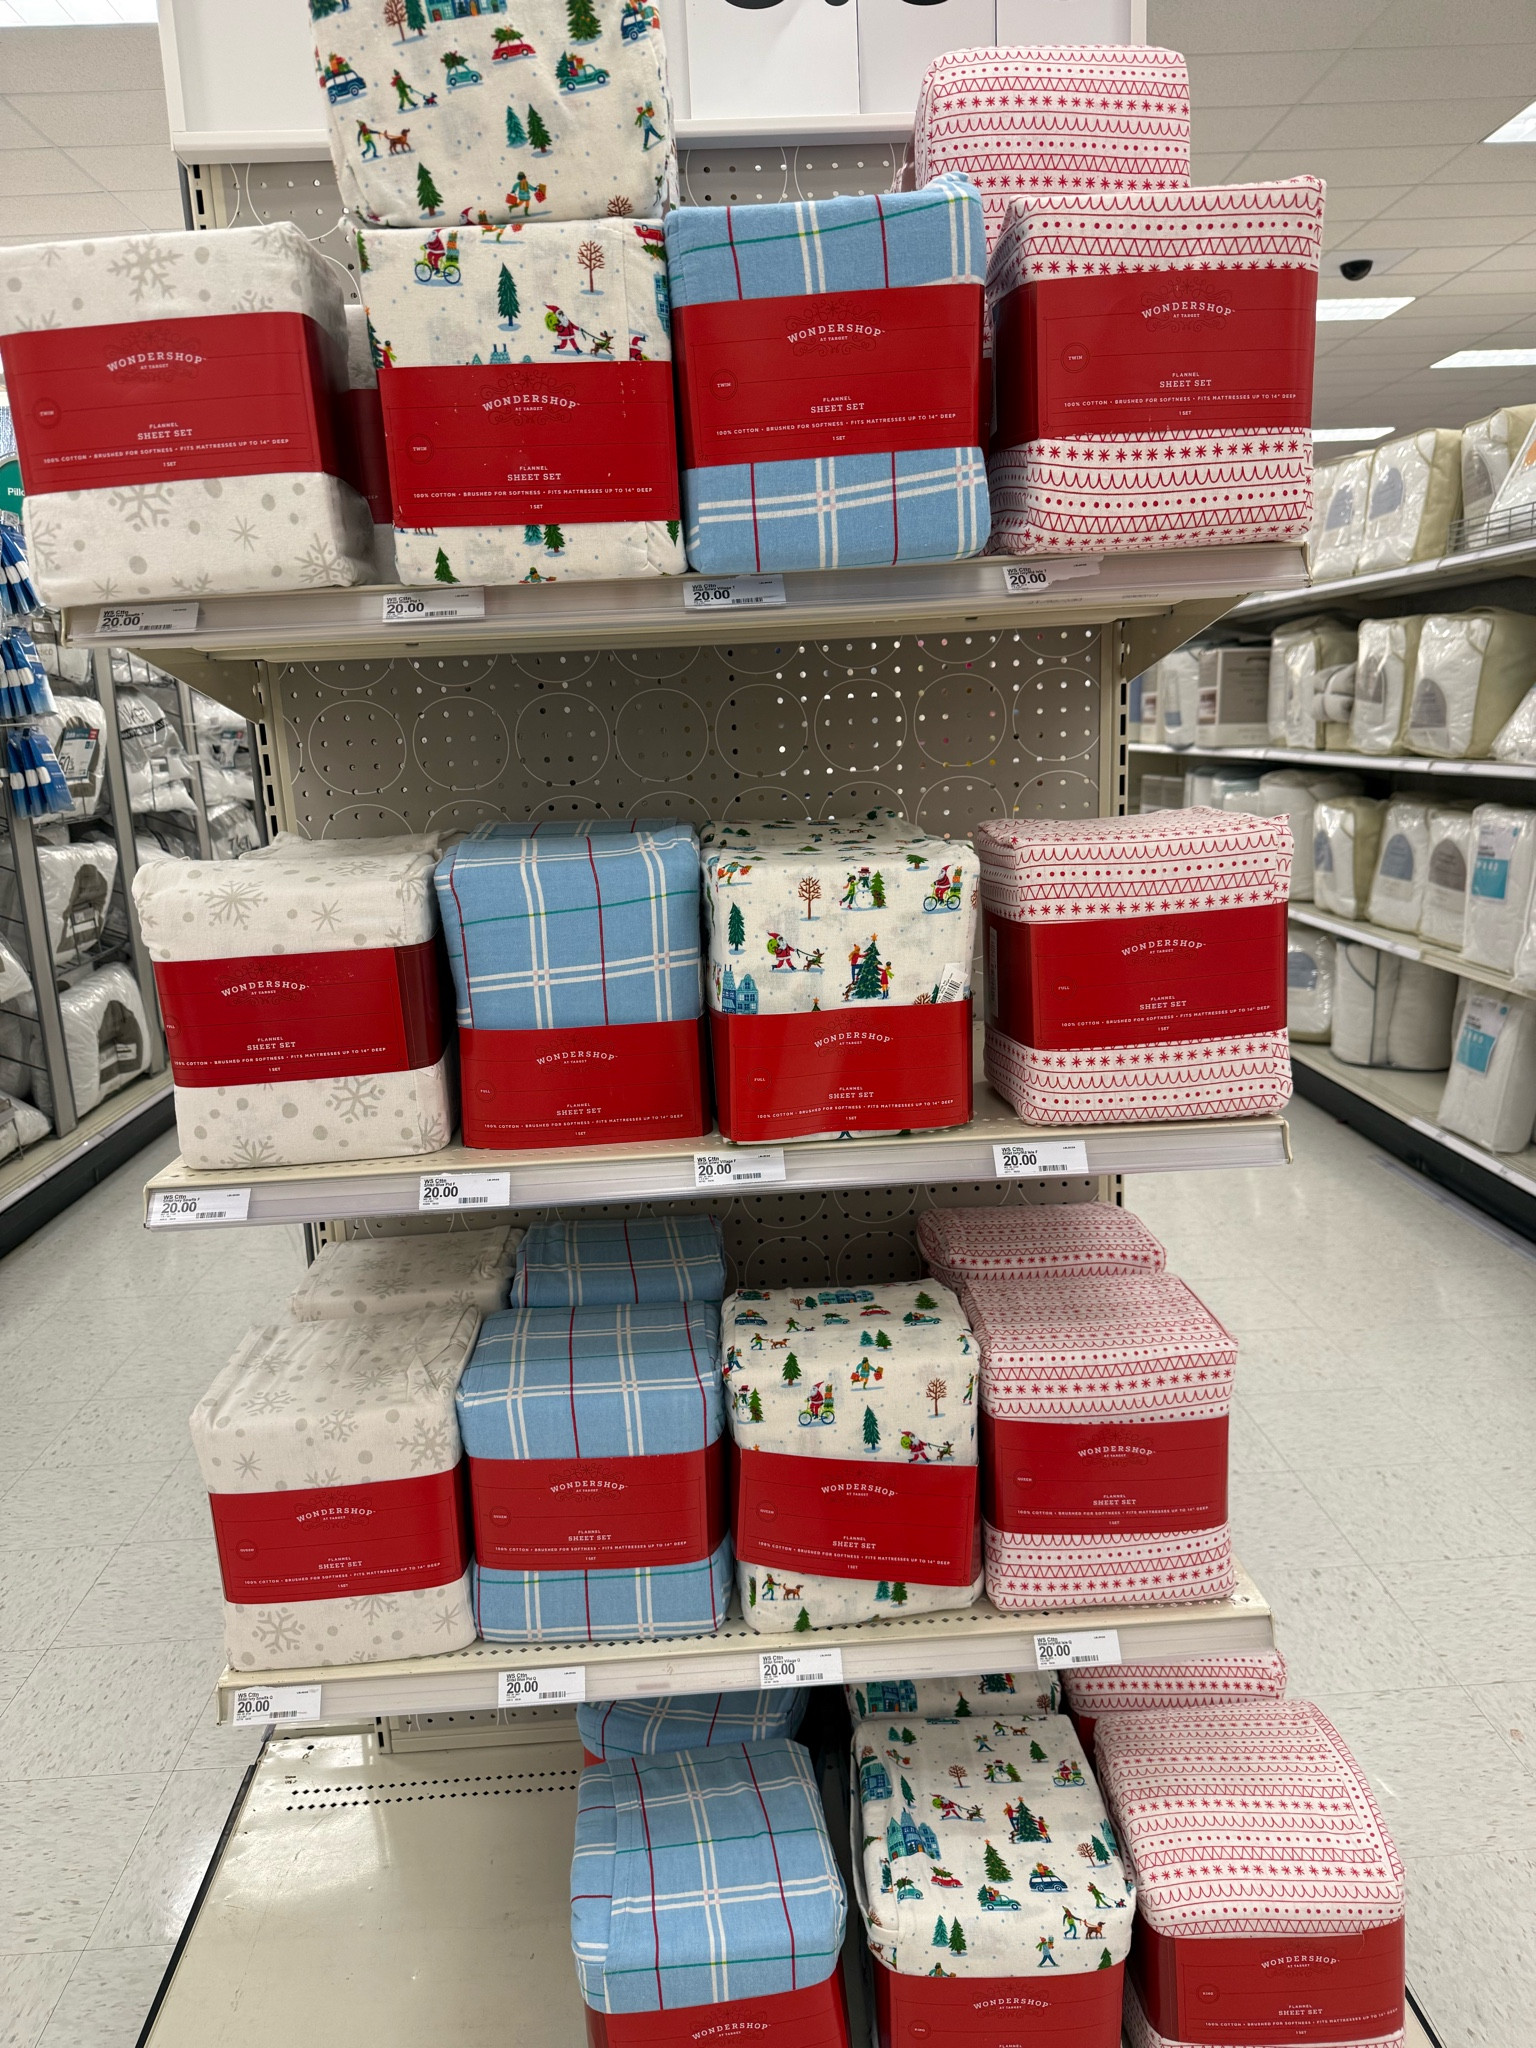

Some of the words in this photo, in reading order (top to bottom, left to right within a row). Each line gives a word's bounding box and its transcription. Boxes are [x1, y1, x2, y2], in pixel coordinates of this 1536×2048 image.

[1142, 302, 1231, 318] WONDERSHOP
[787, 324, 881, 343] WONDERSHOP
[107, 352, 202, 371] WONDERSHOP
[1159, 379, 1191, 388] SHEET
[1194, 379, 1212, 387] SET
[482, 395, 576, 411] WONDERSHOP
[810, 404, 843, 414] SHEET
[846, 402, 865, 411] SET
[137, 430, 171, 440] SHEET
[173, 428, 193, 437] SET
[507, 473, 540, 481] SHEET
[542, 472, 561, 481] SET
[1010, 573, 1046, 585] 20.00
[694, 590, 730, 600] 20.00
[387, 603, 424, 613] 20.00
[102, 617, 140, 627] 20.00
[1122, 940, 1202, 955] WONDERSHOP
[221, 981, 305, 996] WONDERSHOP
[1139, 1002, 1168, 1010] SHEET
[1170, 1000, 1187, 1008] SET
[814, 1032, 890, 1047] WONDERSHOP
[246, 1042, 276, 1051] SHEET
[279, 1041, 296, 1049] SET
[537, 1051, 614, 1064] WONDERSHOP
[828, 1092, 856, 1100] SHEET
[556, 1108, 584, 1116] SHEET
[1003, 1155, 1037, 1166] 20.00
[699, 1164, 731, 1175] 20.00
[424, 1186, 458, 1197] 20.00
[162, 1202, 197, 1213] 20.00
[1078, 1446, 1152, 1457] WONDERSHOP
[551, 1481, 624, 1492] WONDERSHOP
[821, 1484, 894, 1496] WONDERSHOP
[297, 1508, 372, 1522] WONDERSHOP
[832, 1540, 859, 1548] SHEET
[318, 1562, 345, 1570] SHEET
[1039, 1645, 1070, 1657] 20.00
[764, 1663, 795, 1675] 20.00
[507, 1681, 538, 1693] 20.00
[238, 1701, 269, 1713] 20.00
[1261, 1956, 1336, 1968] WONDERSHOP
[974, 1998, 1048, 2009] WONDERSHOP
[692, 2023, 767, 2039] WONDERSHOP
